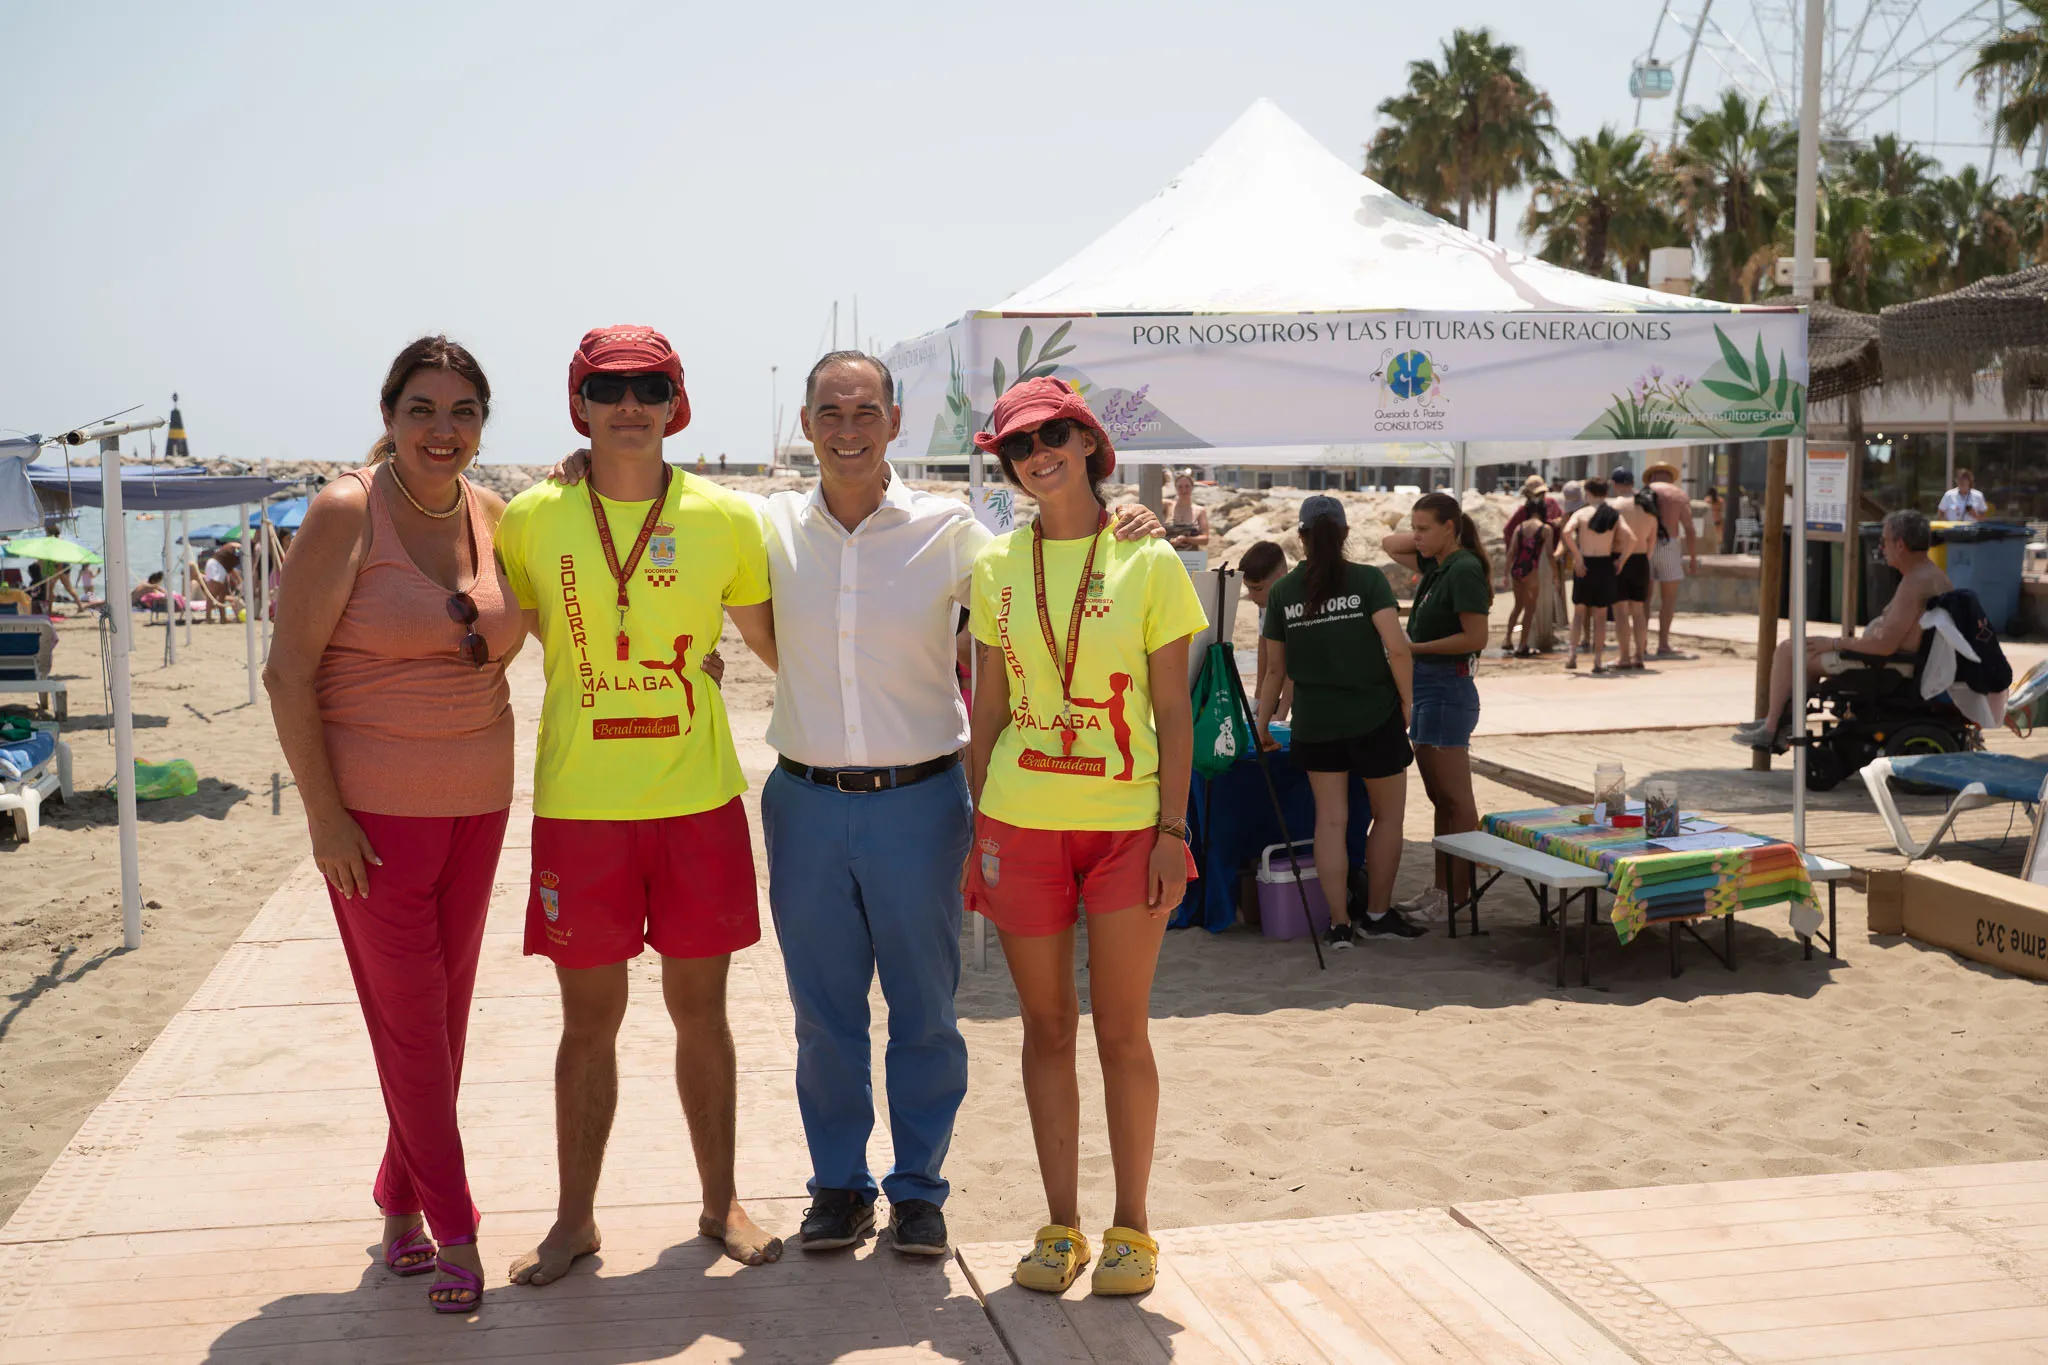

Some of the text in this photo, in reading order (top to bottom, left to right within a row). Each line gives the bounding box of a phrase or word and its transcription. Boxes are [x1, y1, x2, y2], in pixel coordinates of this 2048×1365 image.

[1133, 320, 1672, 345] POR NOSOTROS Y LAS FUTURAS GENERACIONES
[1374, 409, 1446, 419] Quesada & Pastor
[1374, 421, 1444, 432] CONSULTORES
[1284, 594, 1361, 619] MOTOR@
[560, 554, 595, 708] SOCORRISMO
[998, 586, 1028, 733] SOCORRISM
[595, 717, 677, 736] Benalmádena
[1021, 753, 1102, 773] Bnalmádena
[1976, 918, 2048, 960] ame 3x3
